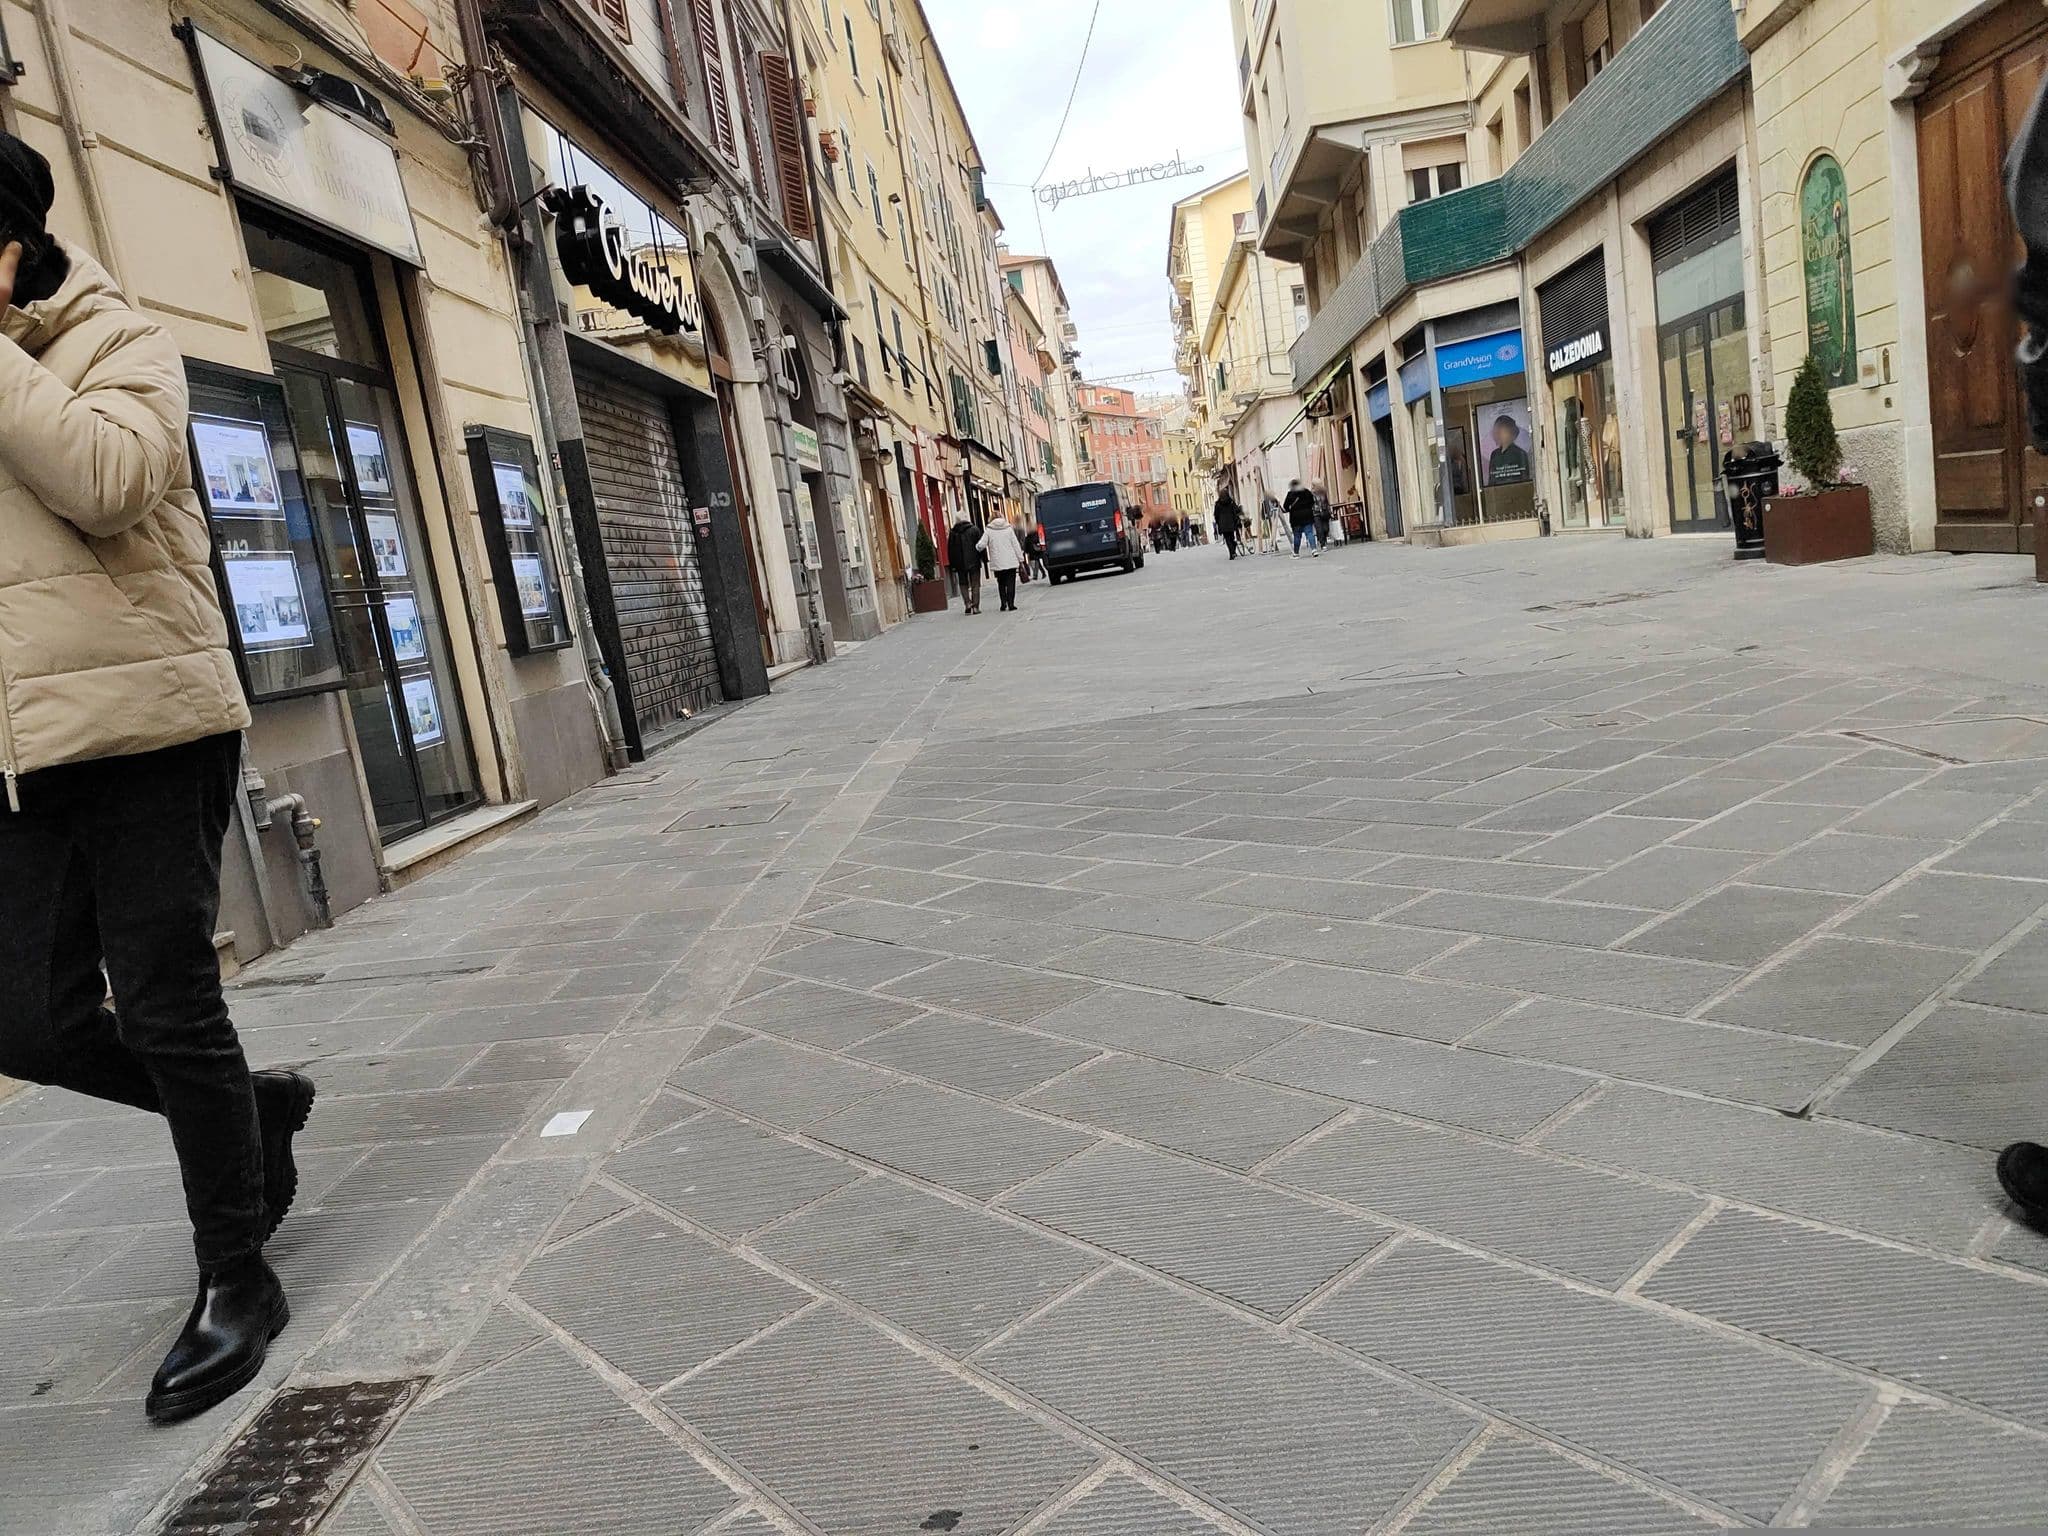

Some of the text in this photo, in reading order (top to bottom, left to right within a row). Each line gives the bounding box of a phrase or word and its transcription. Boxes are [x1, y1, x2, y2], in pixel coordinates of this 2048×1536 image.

[1550, 331, 1602, 373] CALZEDONIA
[1443, 353, 1492, 370] GrandVision
[1081, 498, 1107, 508] amazon
